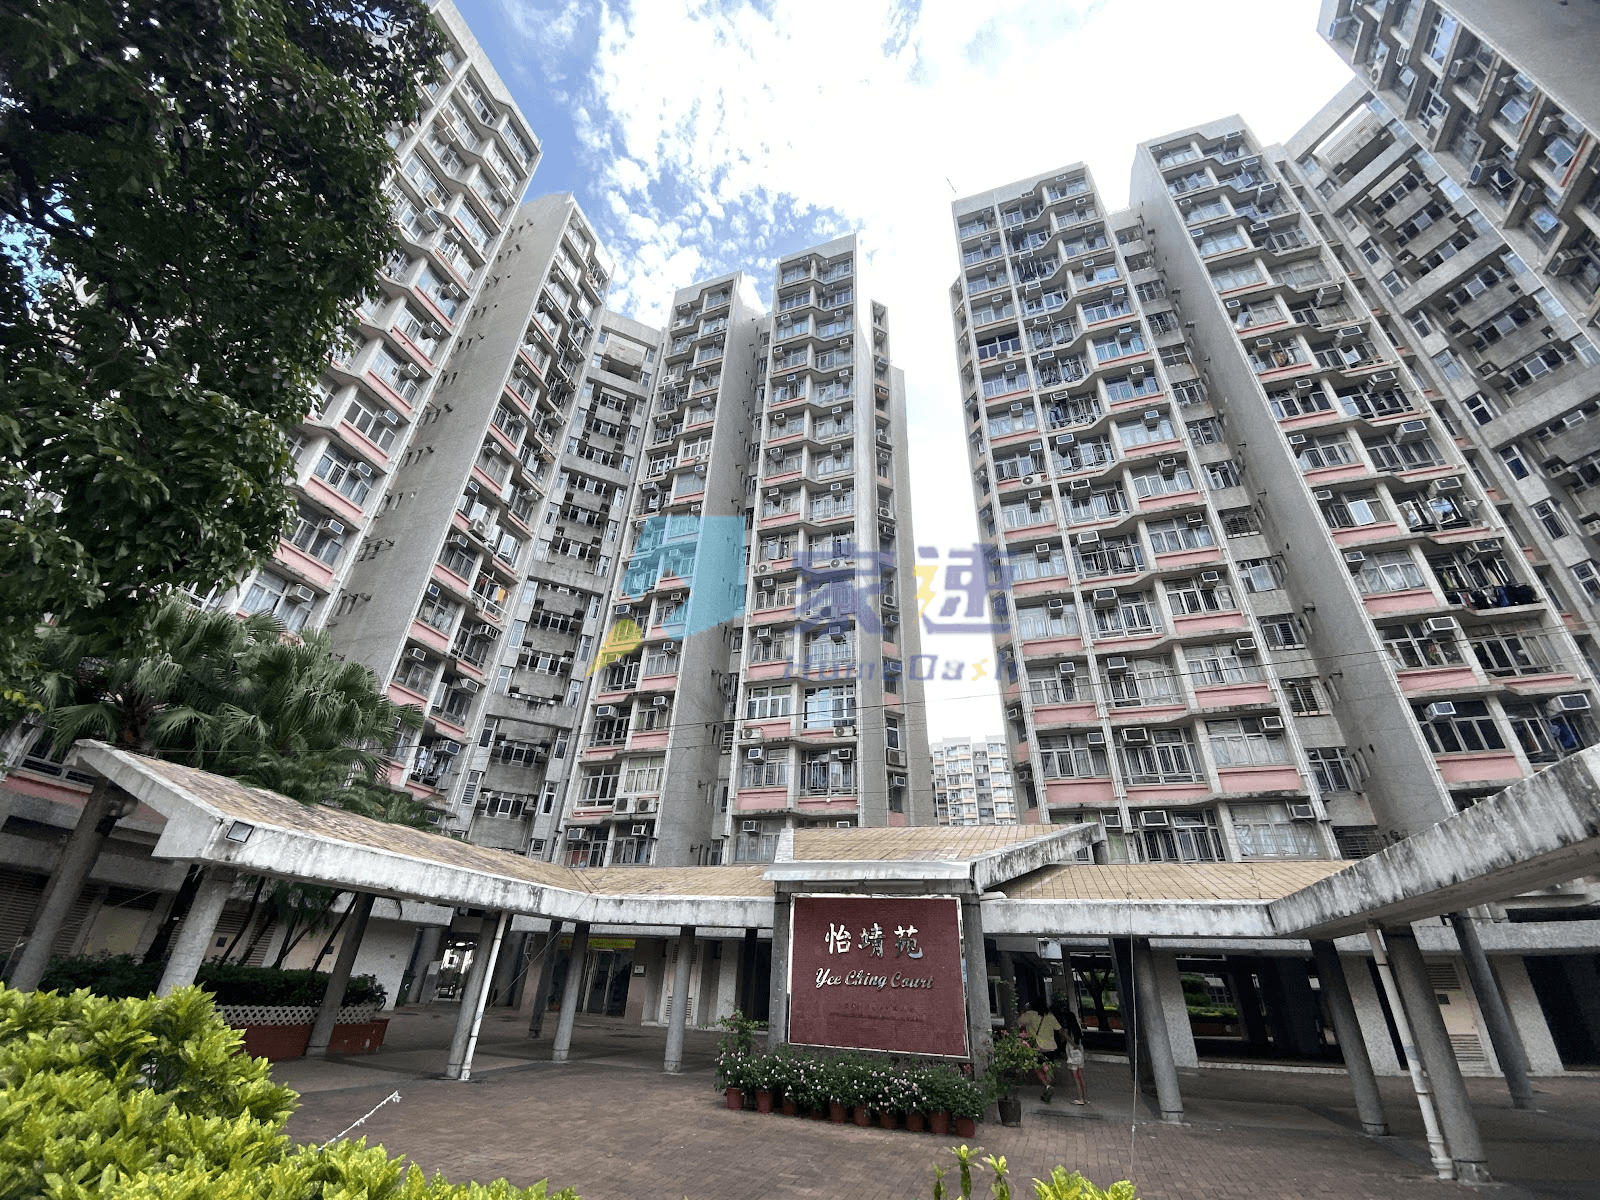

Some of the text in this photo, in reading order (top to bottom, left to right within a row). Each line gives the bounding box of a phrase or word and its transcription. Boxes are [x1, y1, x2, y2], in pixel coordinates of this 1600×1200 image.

[815, 967, 934, 991] Yee Ching Court
